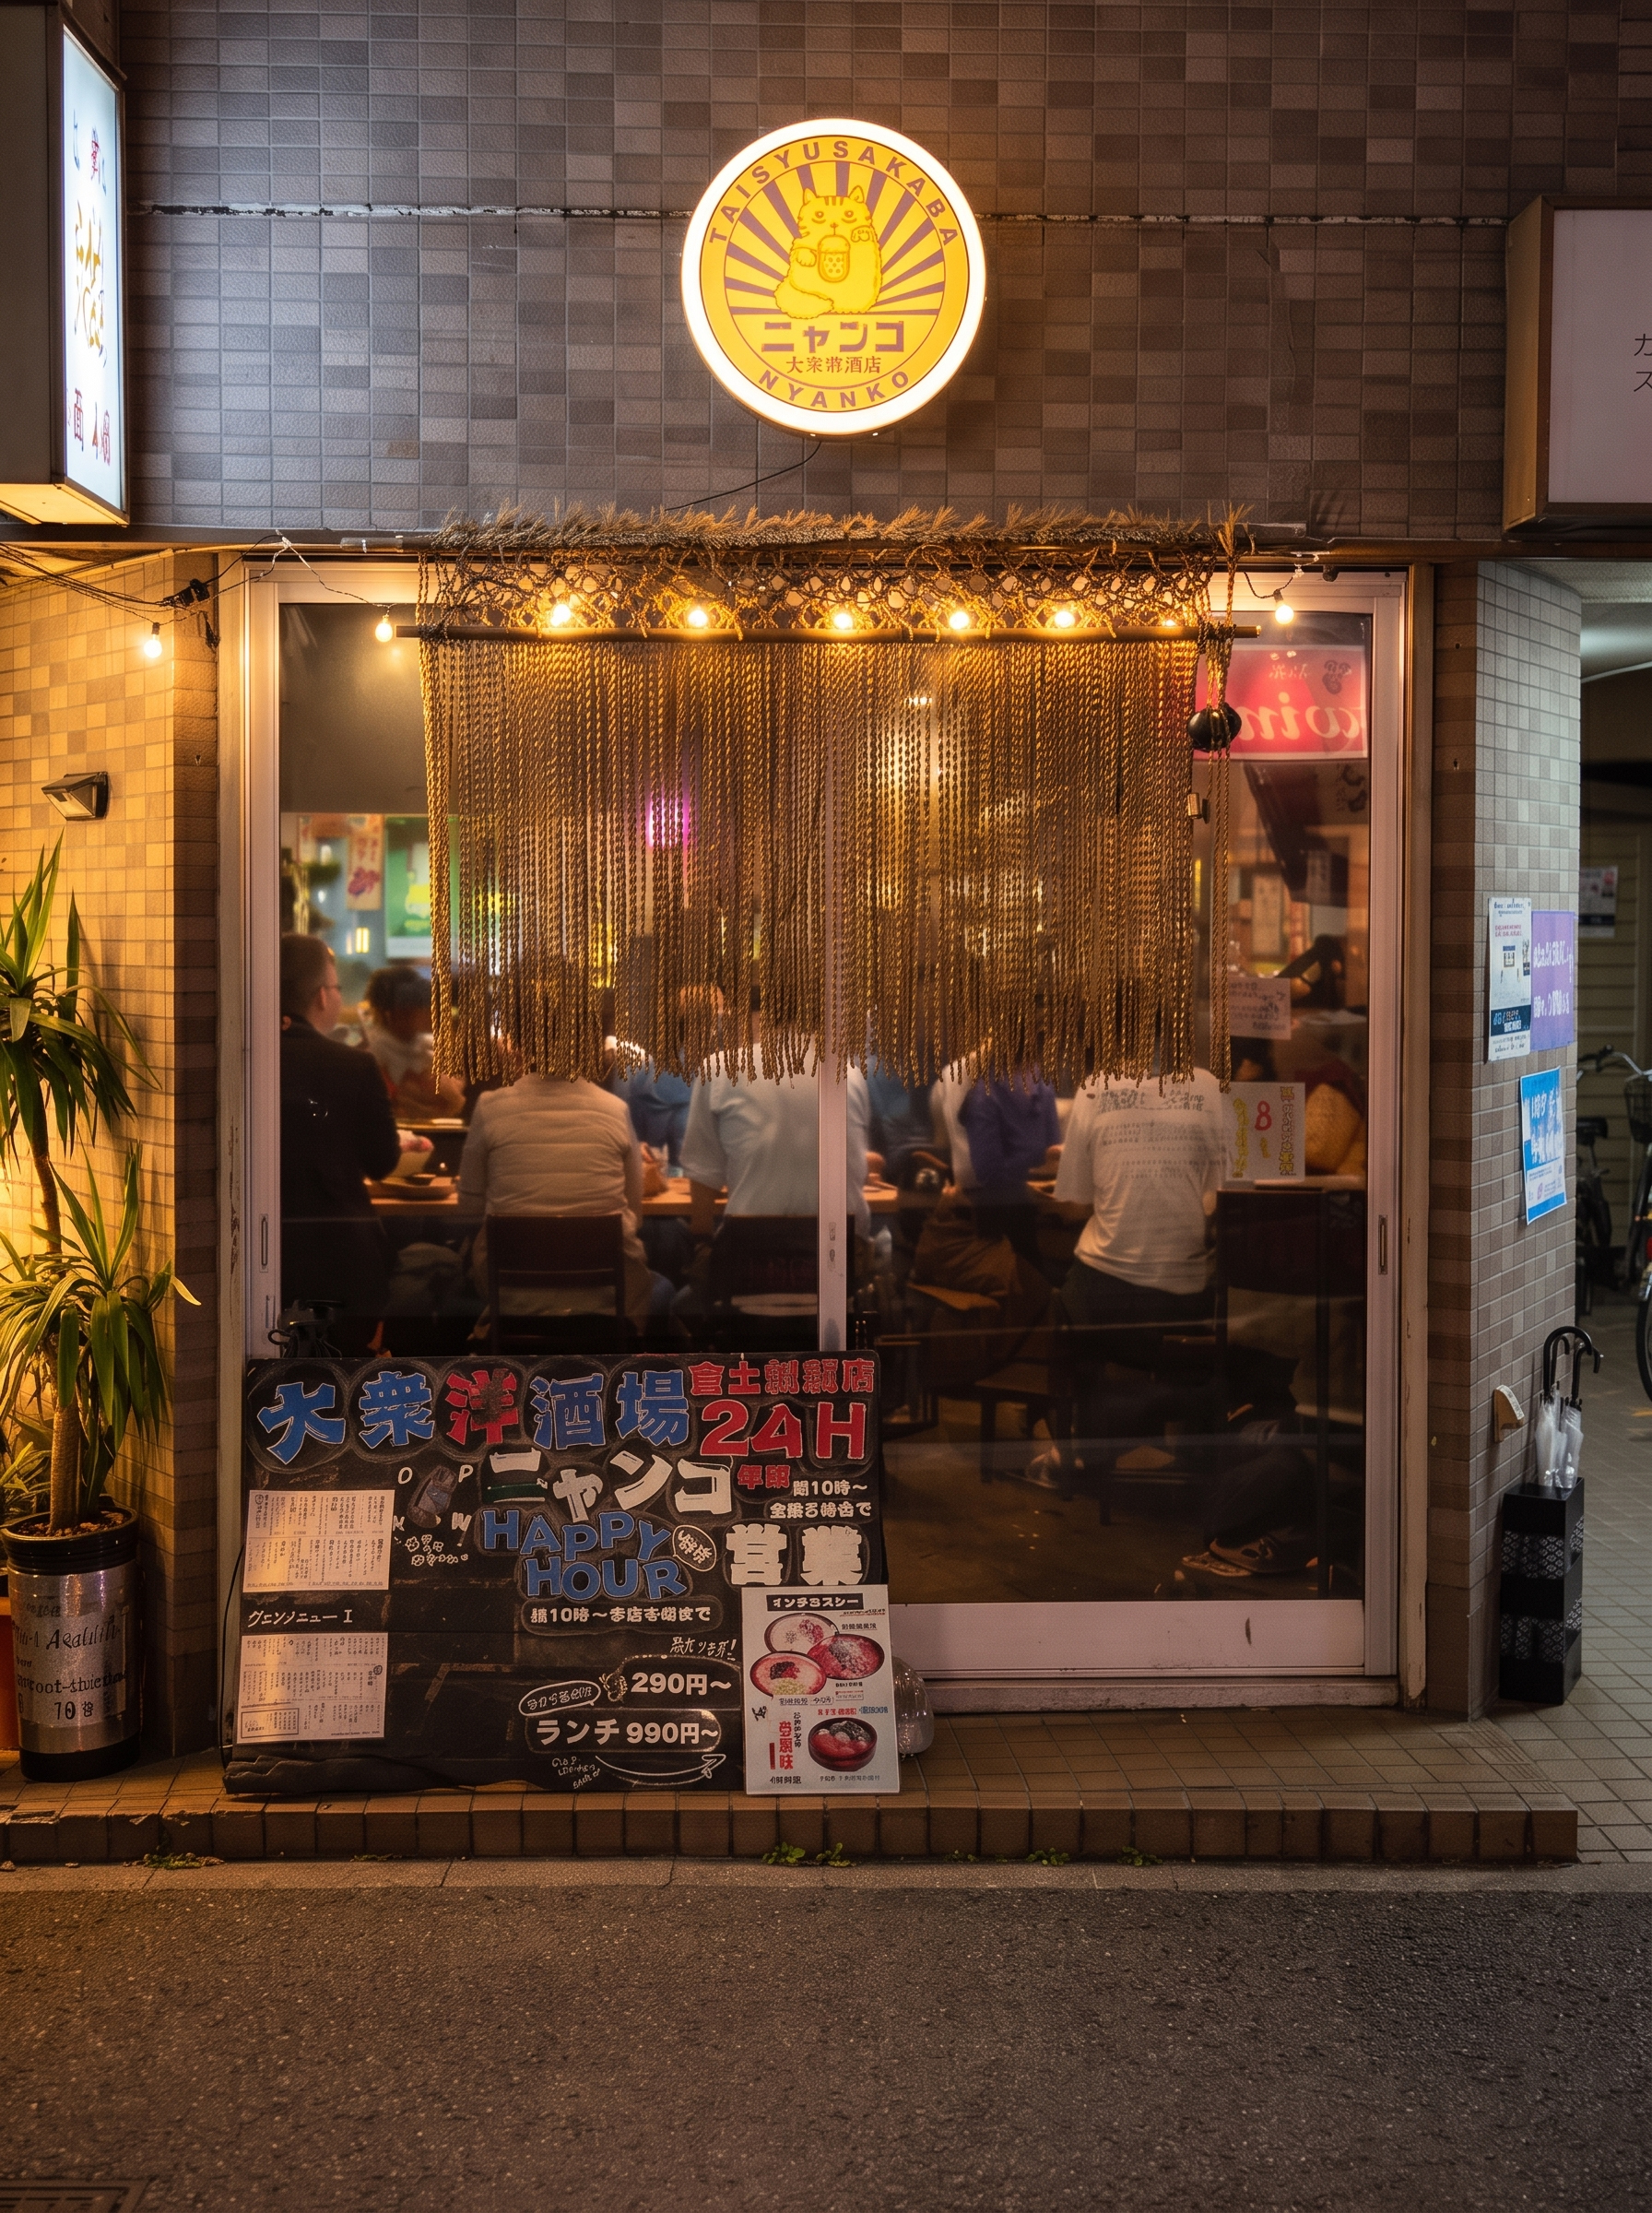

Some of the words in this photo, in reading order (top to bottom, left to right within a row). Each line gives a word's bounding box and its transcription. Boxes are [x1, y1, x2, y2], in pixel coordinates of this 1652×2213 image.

[709, 140, 958, 245] TAISYUSAKABA
[759, 370, 909, 408] NYANKO
[256, 1369, 690, 1465] 大衆洋酒場
[482, 1509, 671, 1562] HAPPY
[525, 1556, 688, 1601] HOUR
[537, 1718, 620, 1746] ランチ
